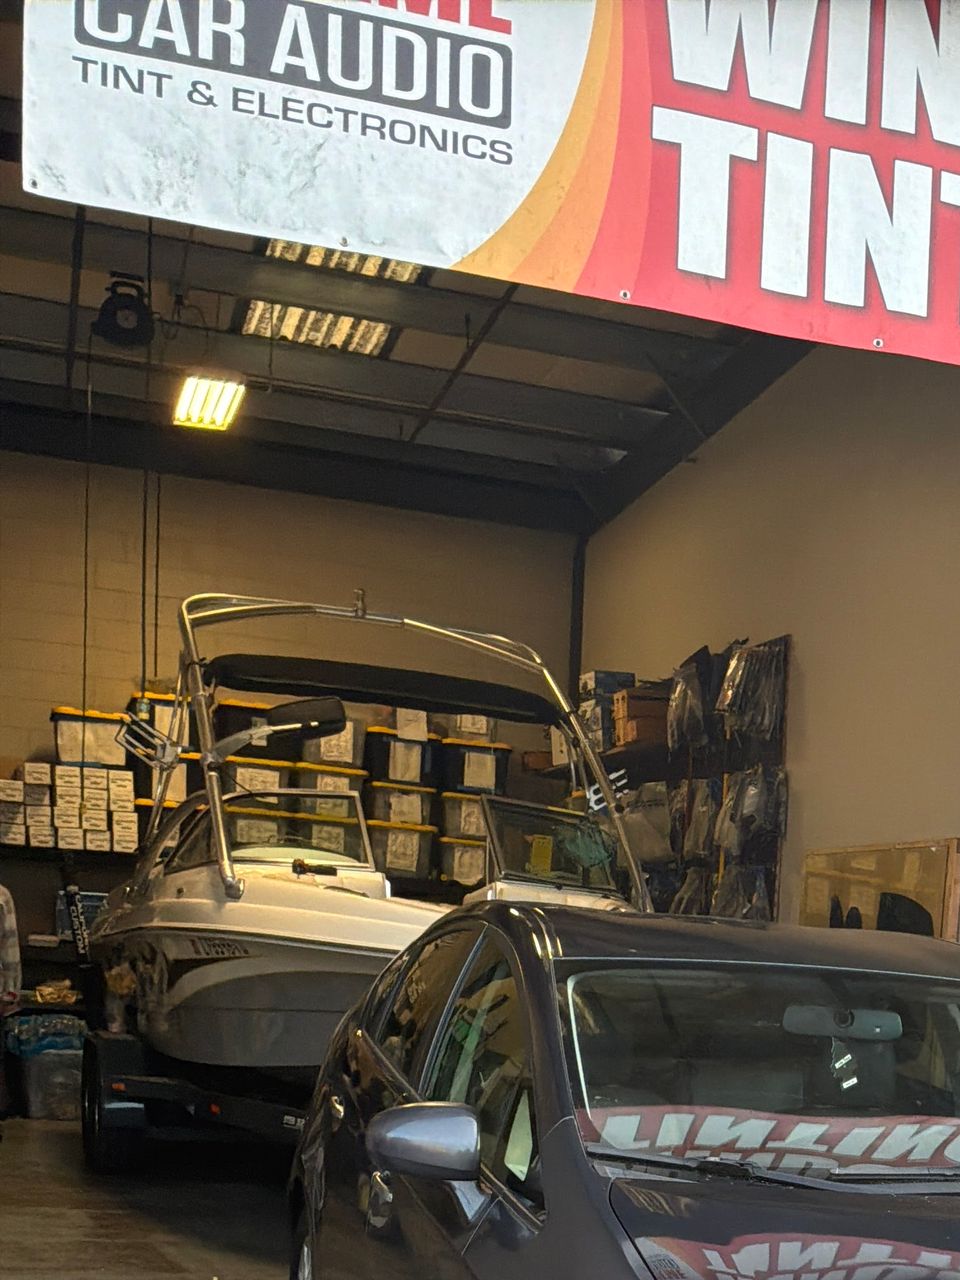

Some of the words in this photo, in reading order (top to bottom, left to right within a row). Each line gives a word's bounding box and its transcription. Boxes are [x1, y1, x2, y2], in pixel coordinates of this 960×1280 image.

[72, 57, 173, 99] TINT
[187, 80, 218, 108] &
[231, 87, 514, 165] ELECTRONICS
[82, 0, 245, 67] CAR
[271, 3, 504, 119] AUDIO
[70, 906, 86, 954] CUSTOM
